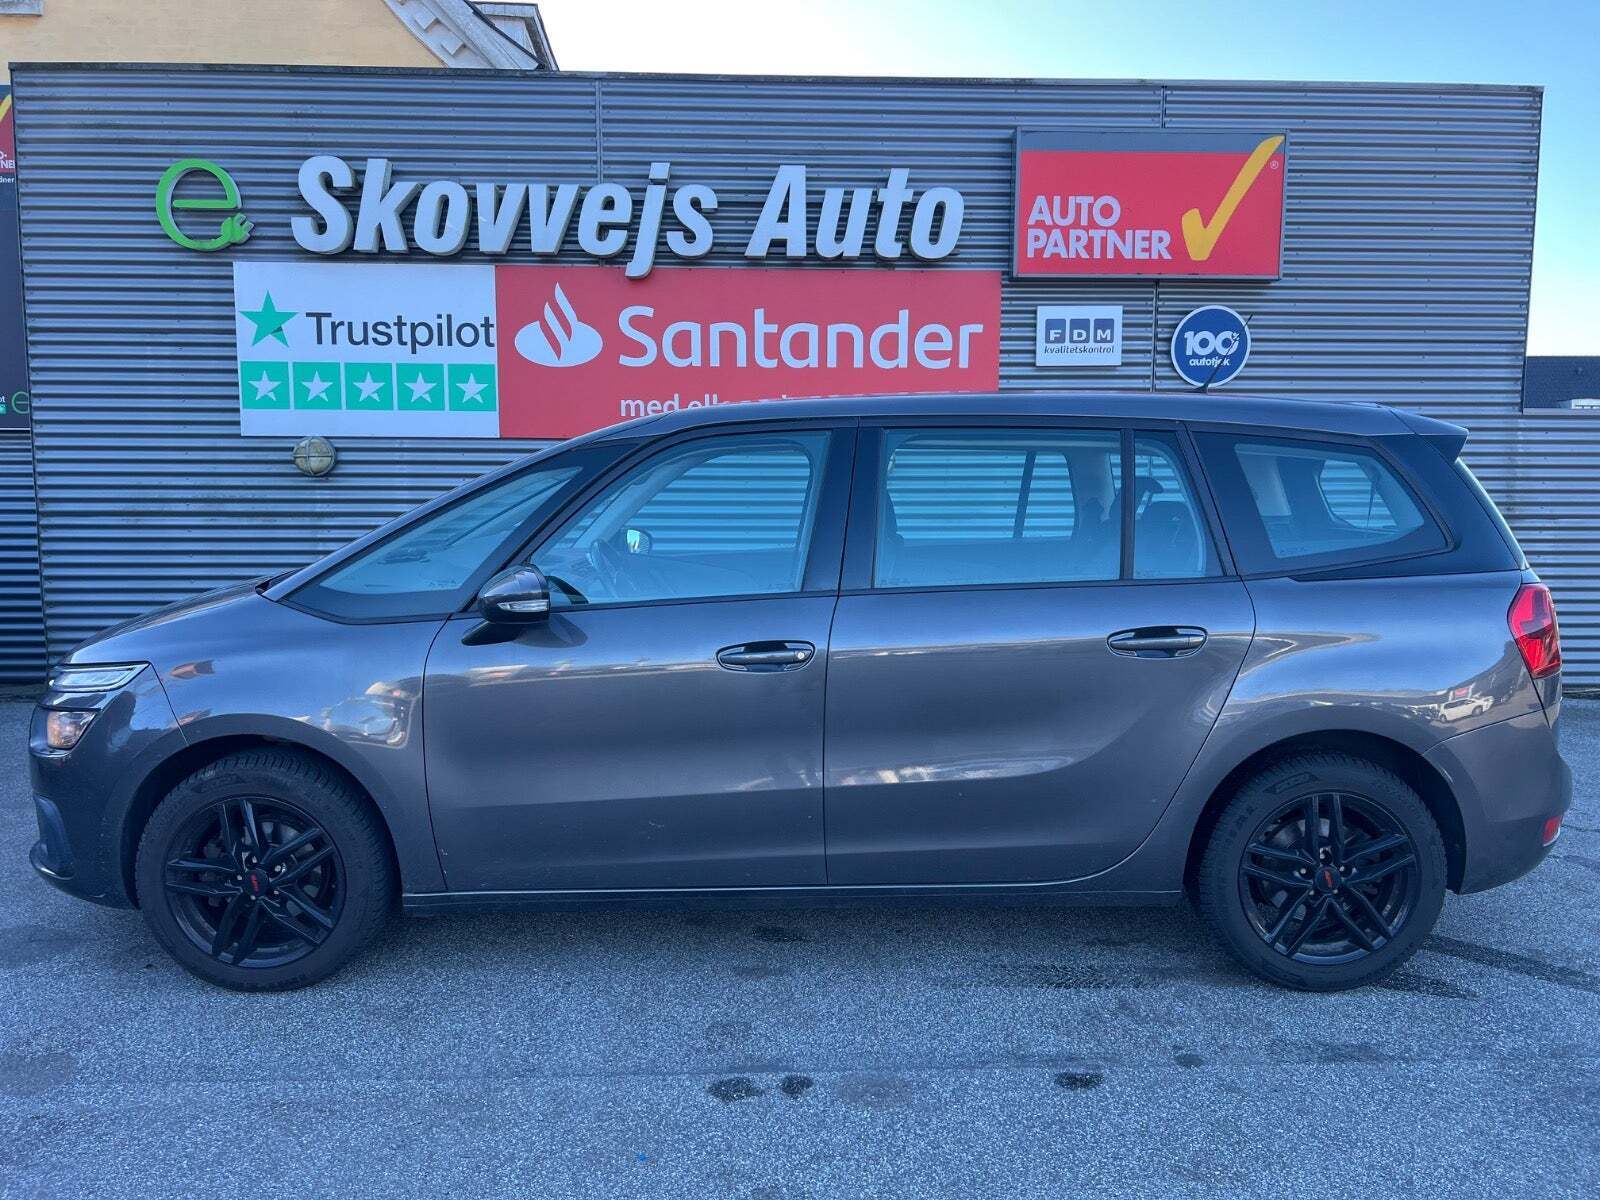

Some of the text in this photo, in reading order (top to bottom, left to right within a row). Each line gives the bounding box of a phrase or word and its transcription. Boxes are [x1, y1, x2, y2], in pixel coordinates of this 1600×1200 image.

[290, 155, 719, 279] Skovvejs
[744, 164, 965, 261] Auto
[1027, 195, 1121, 227] AUTO
[1026, 228, 1173, 260] PARTNER
[305, 311, 495, 354] Trustpilot
[618, 306, 984, 370] Santander
[1044, 345, 1115, 354] kvalitetskontrol
[620, 393, 680, 417] med
